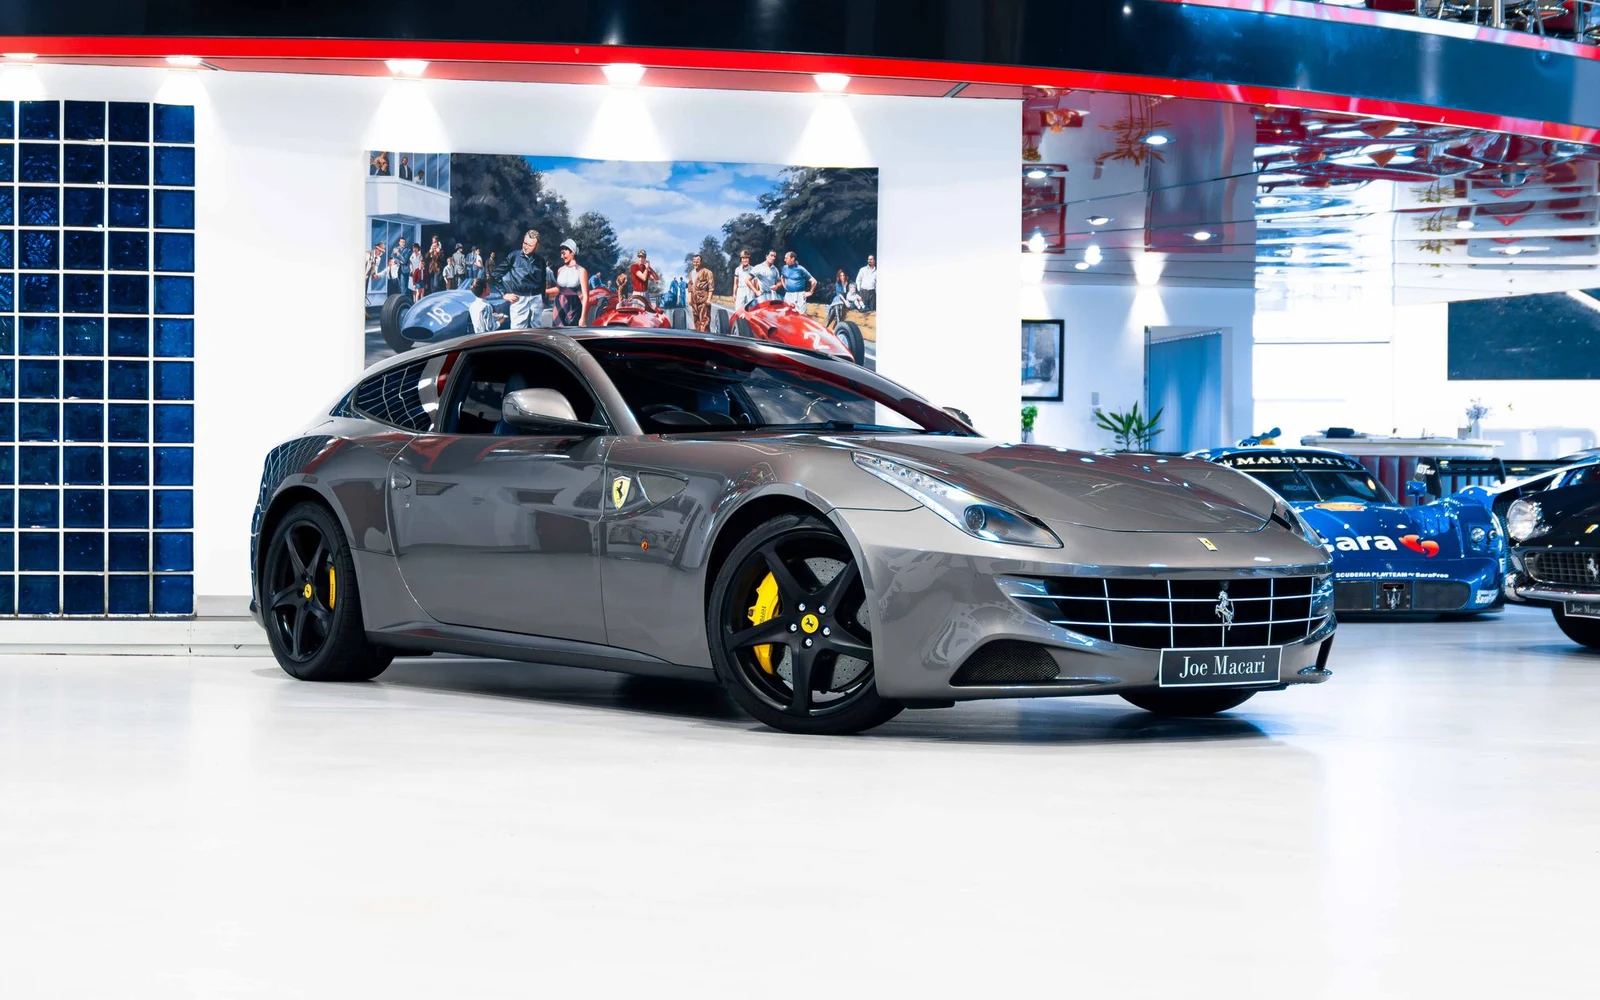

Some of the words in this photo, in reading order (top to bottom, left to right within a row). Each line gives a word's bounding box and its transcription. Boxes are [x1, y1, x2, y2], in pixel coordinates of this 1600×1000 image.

[803, 331, 830, 350] 2
[1179, 656, 1208, 678] Joe
[1212, 654, 1266, 675] Macari
